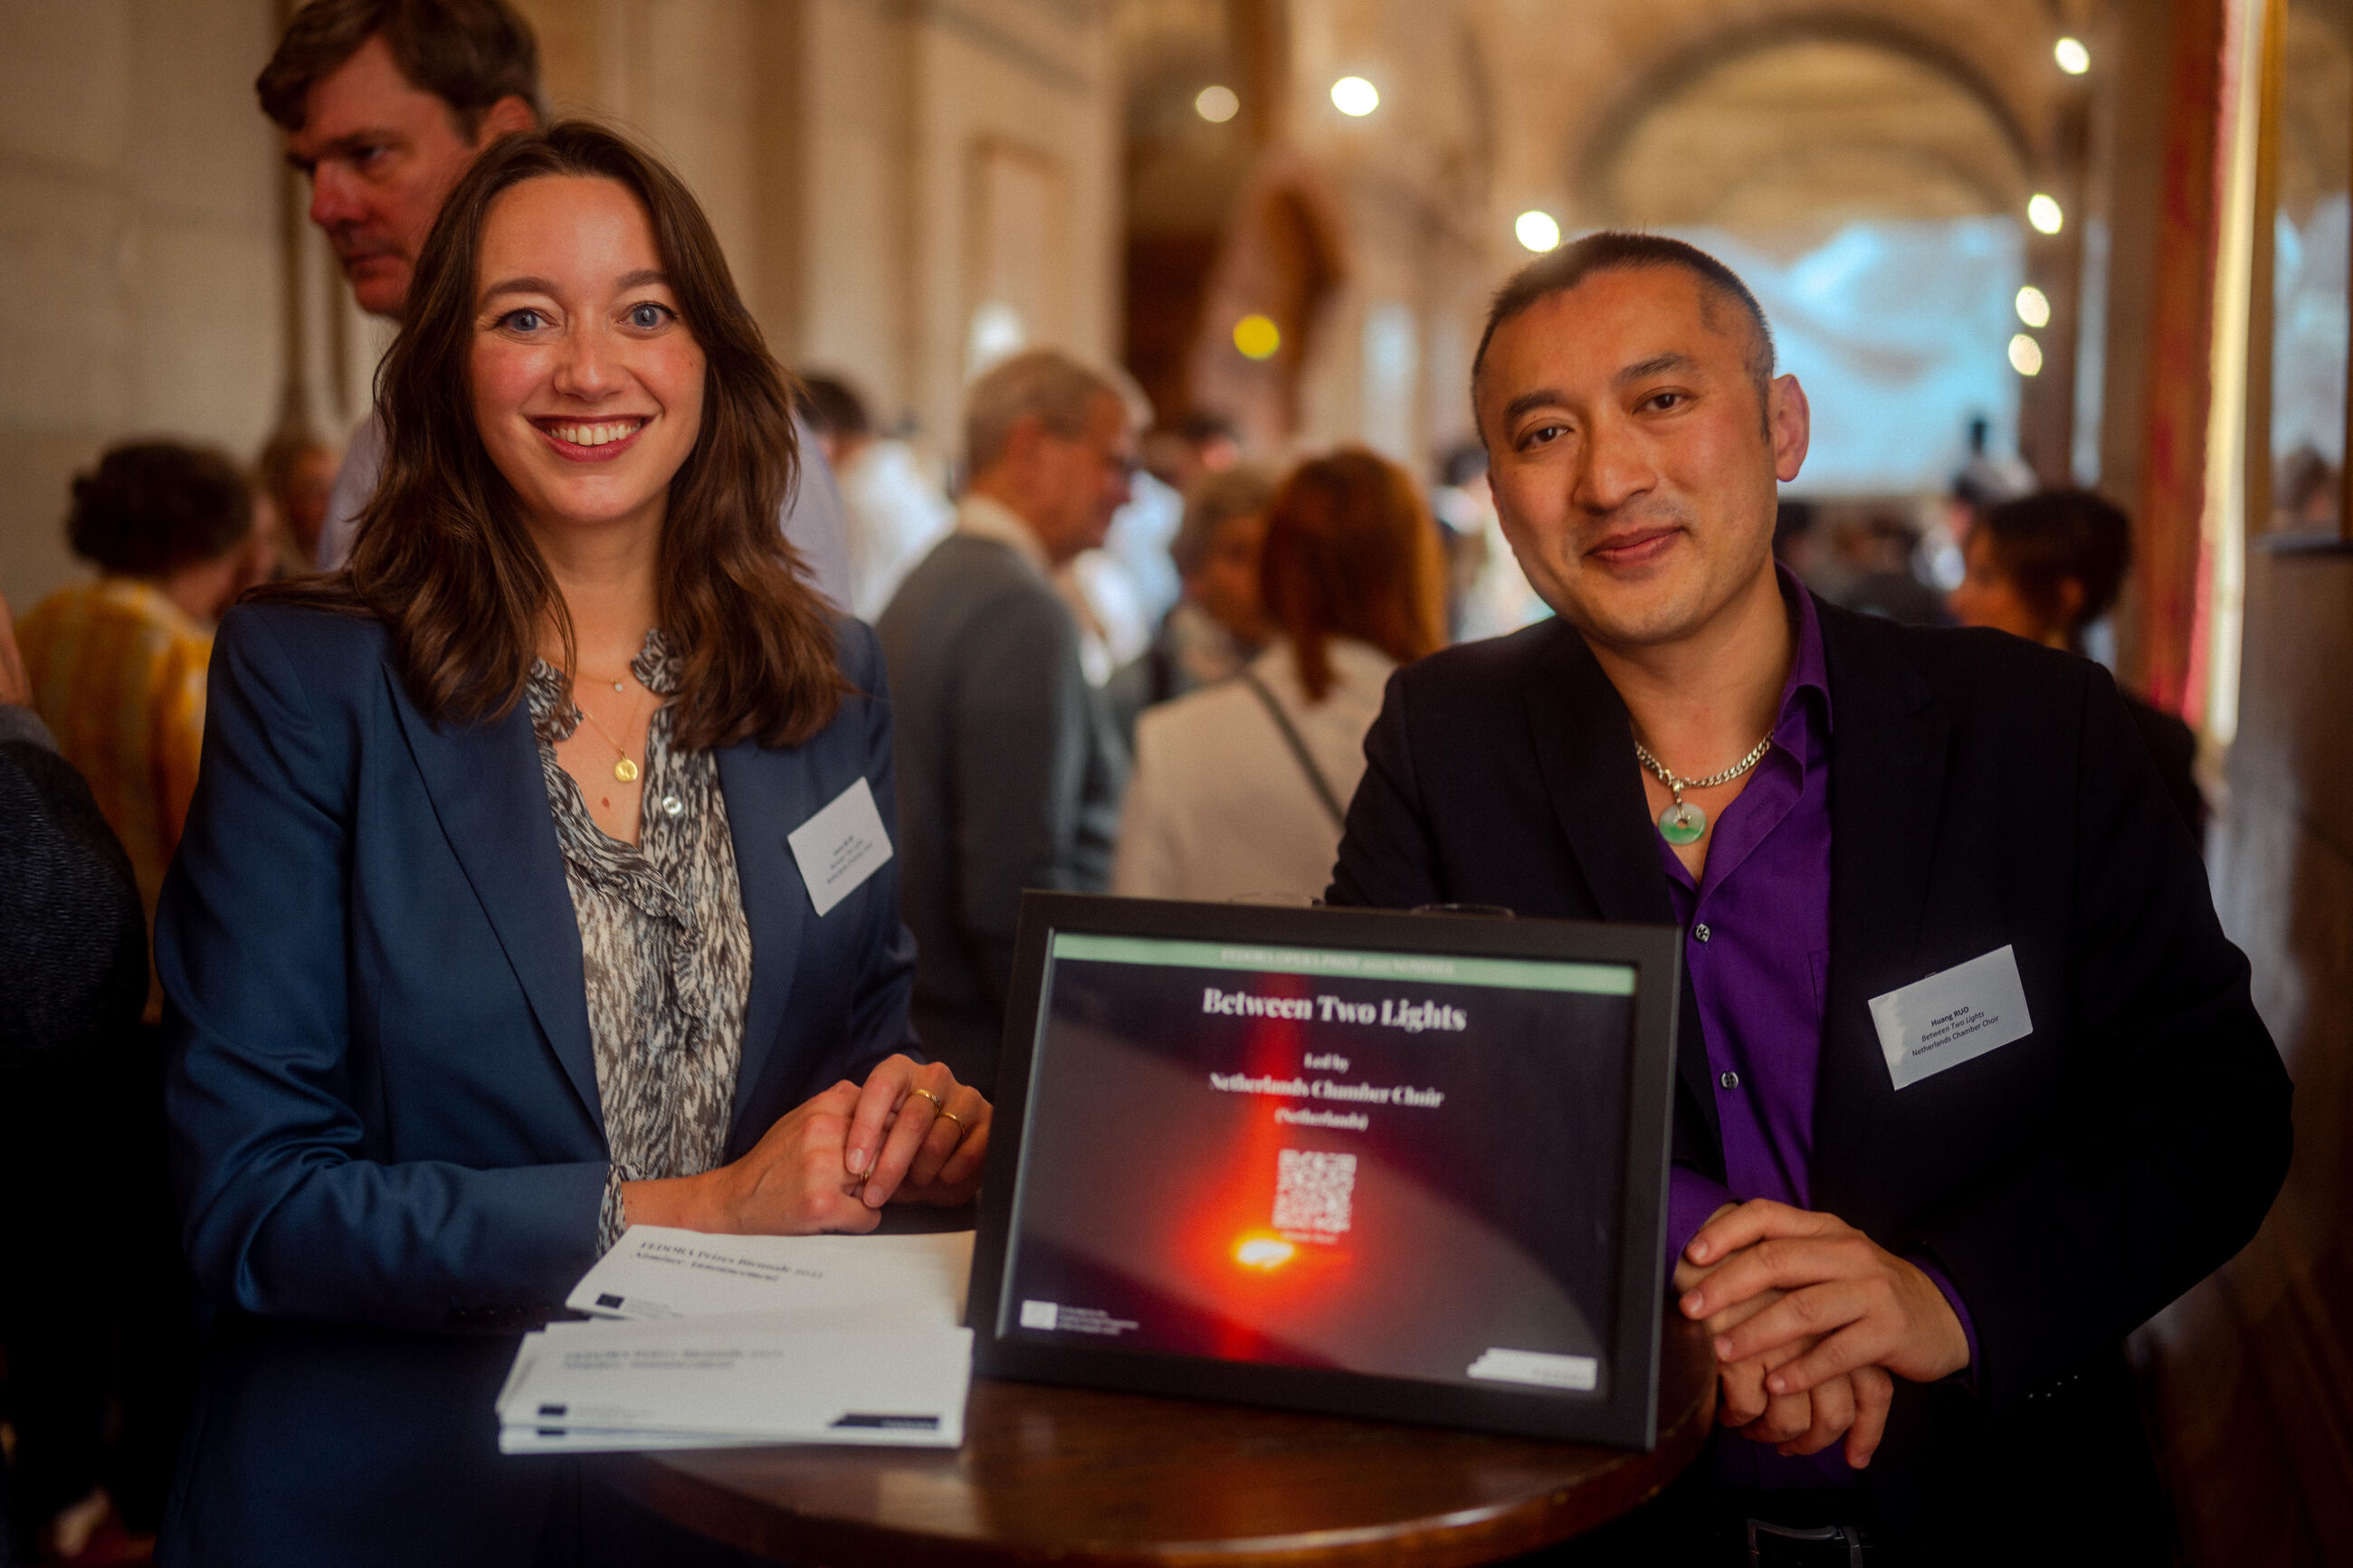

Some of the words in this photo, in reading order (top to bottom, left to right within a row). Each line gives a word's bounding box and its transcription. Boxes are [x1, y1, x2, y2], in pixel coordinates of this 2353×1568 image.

[1203, 987, 1313, 1020] Between
[1317, 995, 1377, 1024] Two
[1380, 998, 1467, 1033] Lights
[1921, 1026, 1950, 1042] Between
[1951, 1021, 1965, 1030] Two
[1966, 1012, 1985, 1024] Lights
[1930, 1013, 1954, 1027] Huang
[1953, 1006, 1969, 1017] RUO
[1911, 1036, 1951, 1057] Netherlands
[1952, 1023, 1981, 1040] Chamber
[1982, 1015, 1999, 1028] Choir
[1210, 1072, 1310, 1098] Netherlands
[1311, 1079, 1389, 1104] Chamber
[1391, 1085, 1444, 1108] Choir
